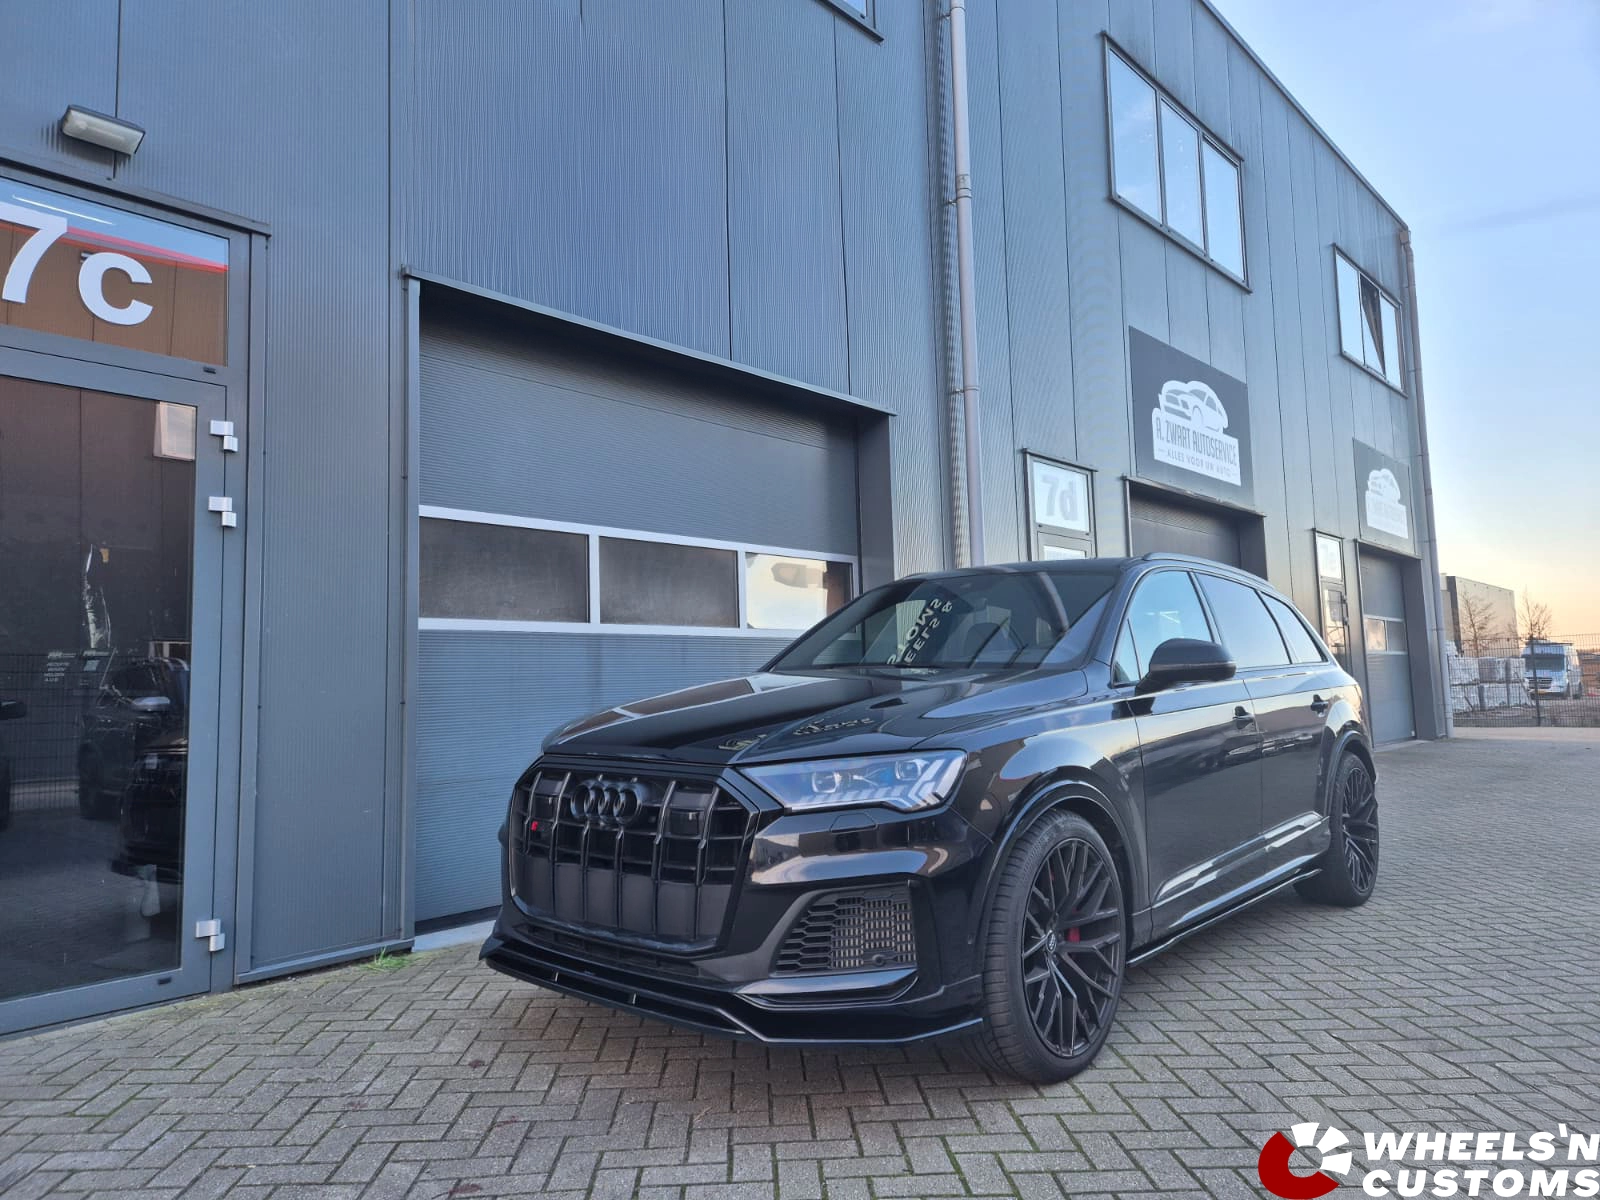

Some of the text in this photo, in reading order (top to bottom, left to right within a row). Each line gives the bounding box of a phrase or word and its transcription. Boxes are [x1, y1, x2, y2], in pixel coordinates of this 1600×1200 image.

[1166, 420, 1191, 449] ZWART
[1192, 429, 1237, 466] AUTOSERVICE
[1167, 448, 1185, 462] ALLES
[1041, 474, 1079, 521] 7d
